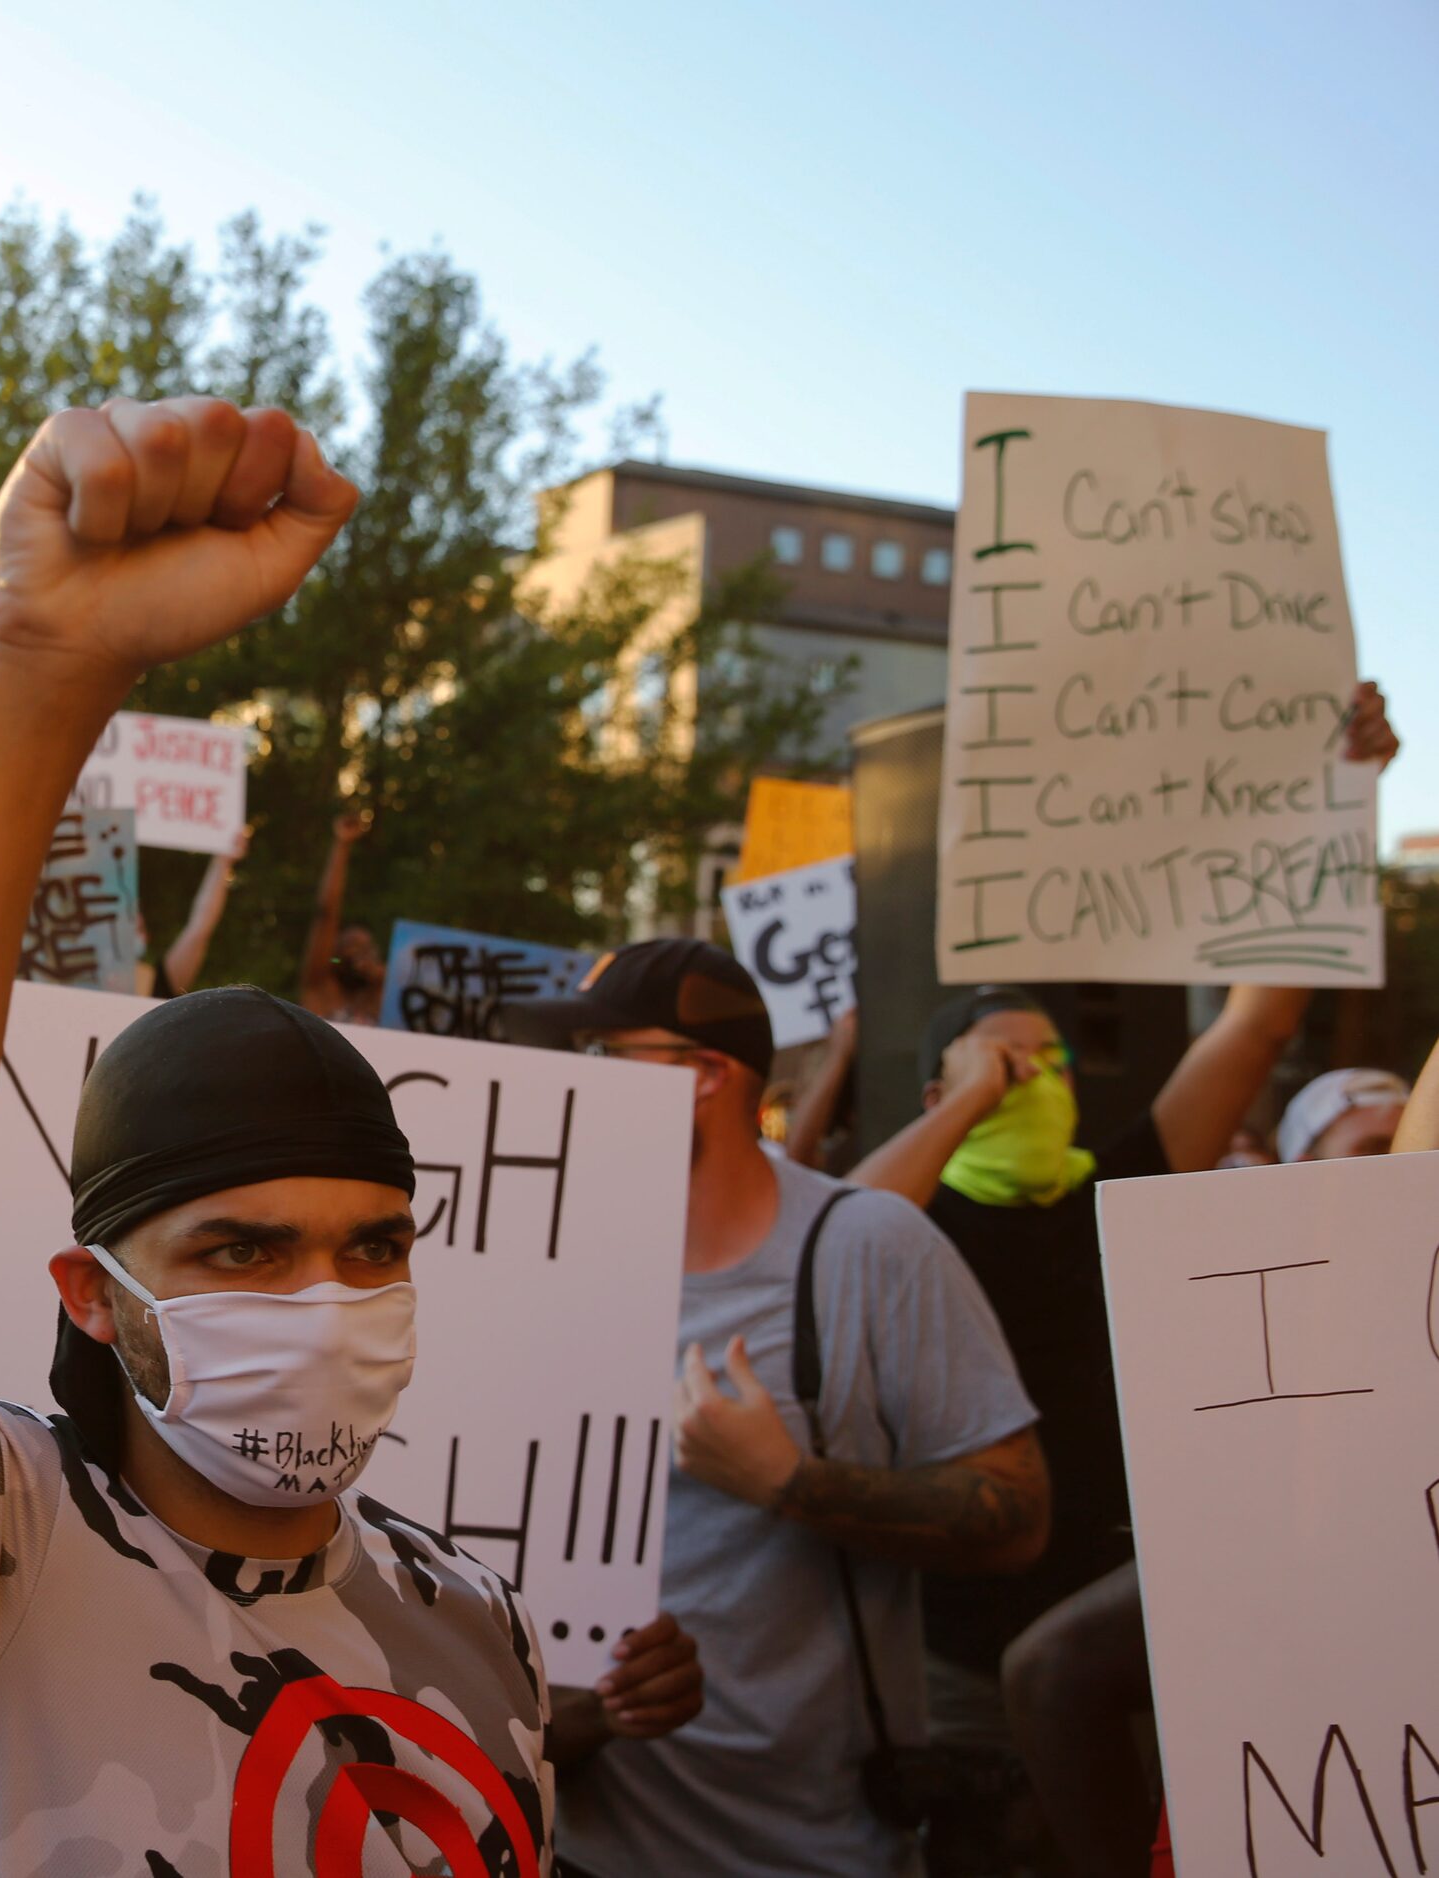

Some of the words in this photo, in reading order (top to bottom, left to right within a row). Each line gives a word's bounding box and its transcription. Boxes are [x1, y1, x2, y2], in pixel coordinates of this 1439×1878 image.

[972, 429, 1037, 562] I
[1063, 467, 1198, 545] Can't
[965, 582, 1044, 655] I
[1067, 576, 1214, 636] Can't
[1216, 570, 1336, 634] Drive
[961, 684, 1036, 749] I
[1054, 669, 1212, 739] Can't
[955, 777, 1035, 843] I
[951, 870, 1027, 953] I
[1188, 1259, 1374, 1412] I
